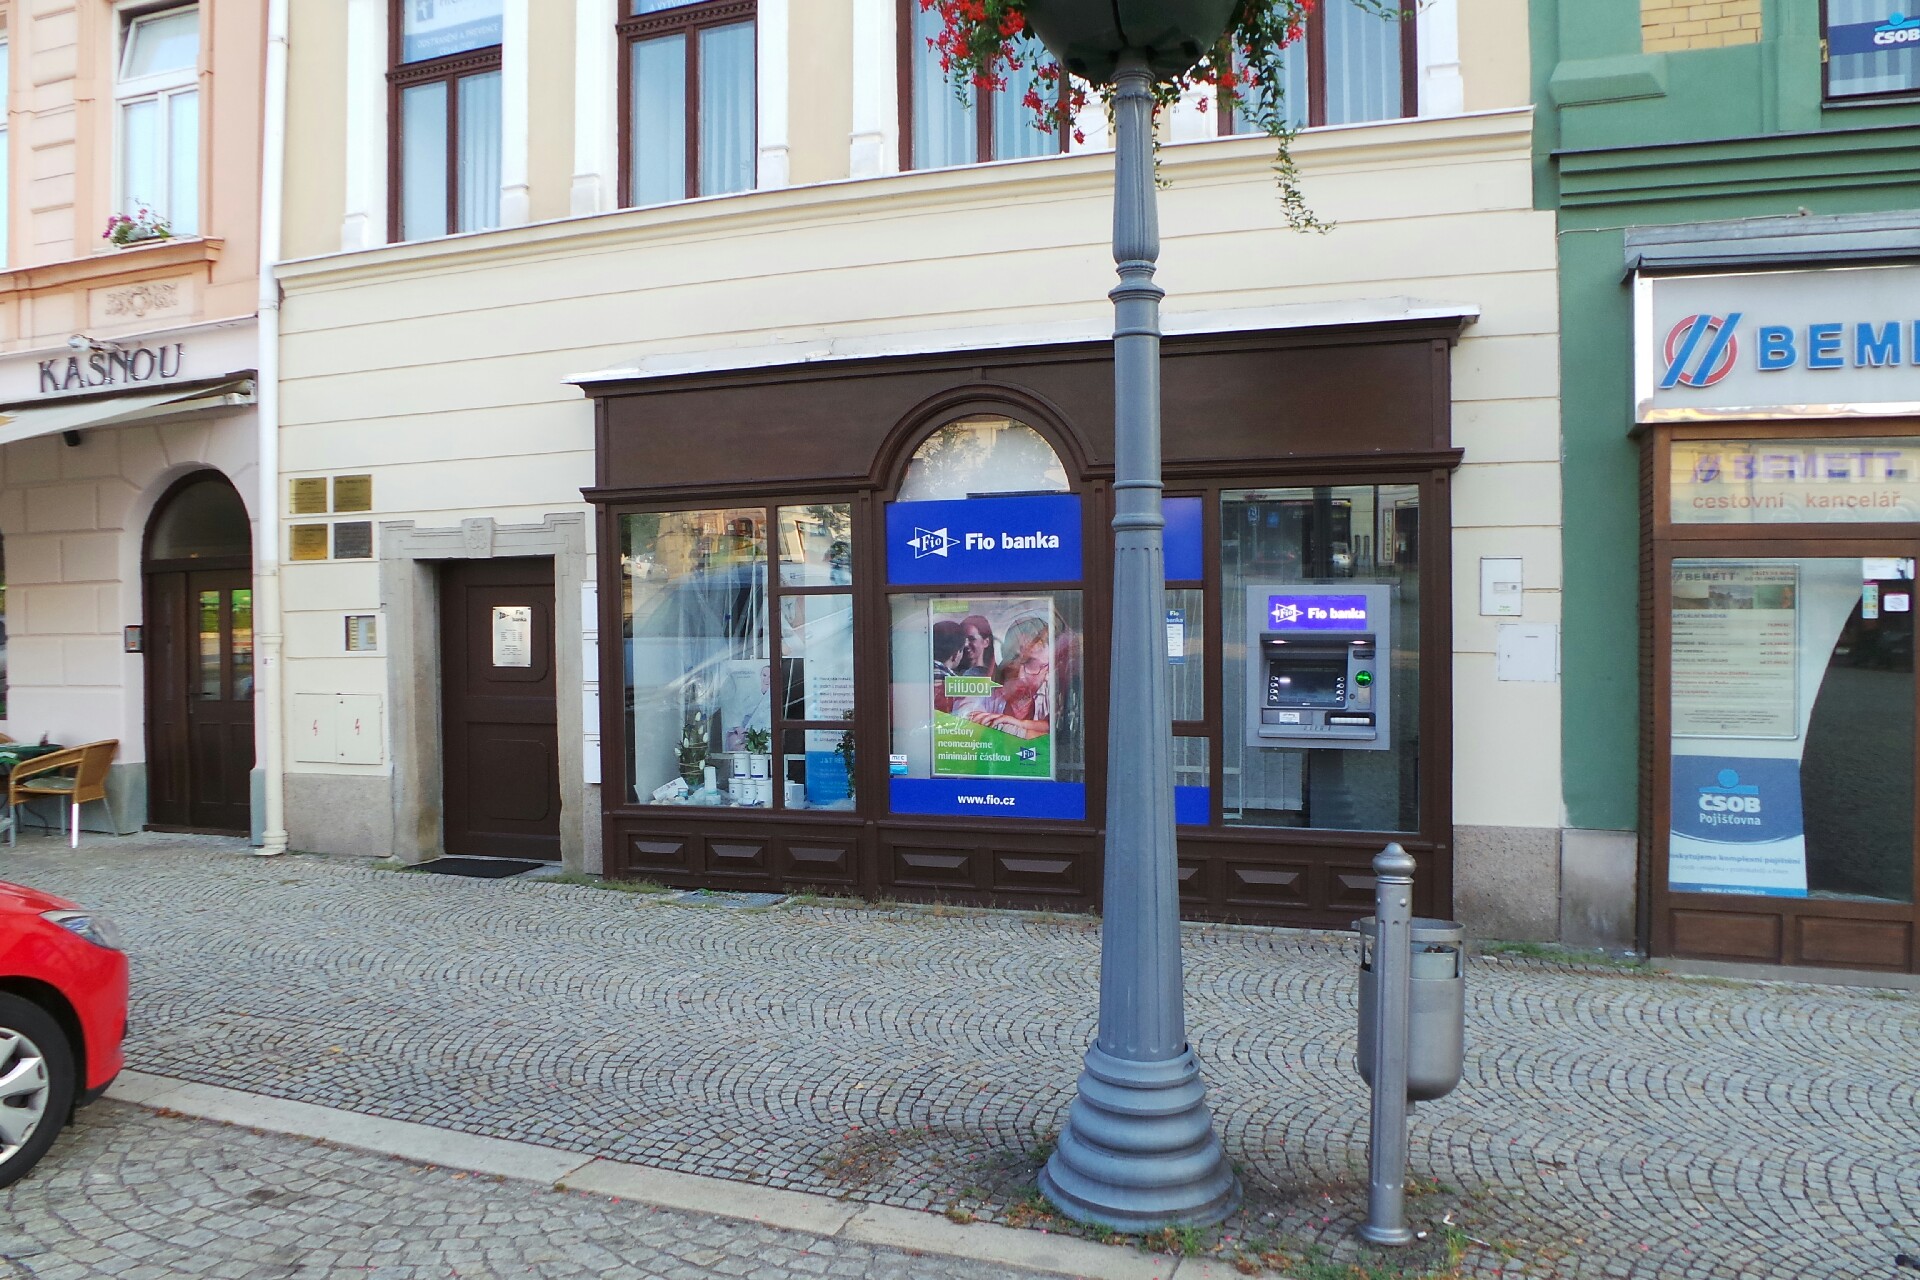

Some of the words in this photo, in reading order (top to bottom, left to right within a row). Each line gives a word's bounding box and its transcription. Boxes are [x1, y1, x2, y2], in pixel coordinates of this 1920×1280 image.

[1874, 29, 1920, 45] ČSOB
[1756, 320, 1920, 371] BEM
[1733, 451, 1903, 480] BEMETT
[1692, 491, 1784, 509] cestovní
[1806, 491, 1901, 508] kancelář
[920, 535, 942, 552] Fio
[965, 533, 995, 550] Fio
[1001, 531, 1060, 550] banka
[1307, 607, 1327, 619] Fio
[1330, 608, 1366, 619] banka
[938, 739, 993, 751] neomezujeme
[938, 750, 978, 761] minimální
[979, 752, 1011, 762] částkou
[957, 794, 1016, 806] www.fio.cz
[1699, 793, 1761, 813] ČSOB
[1699, 813, 1762, 826] Pojišťovna
